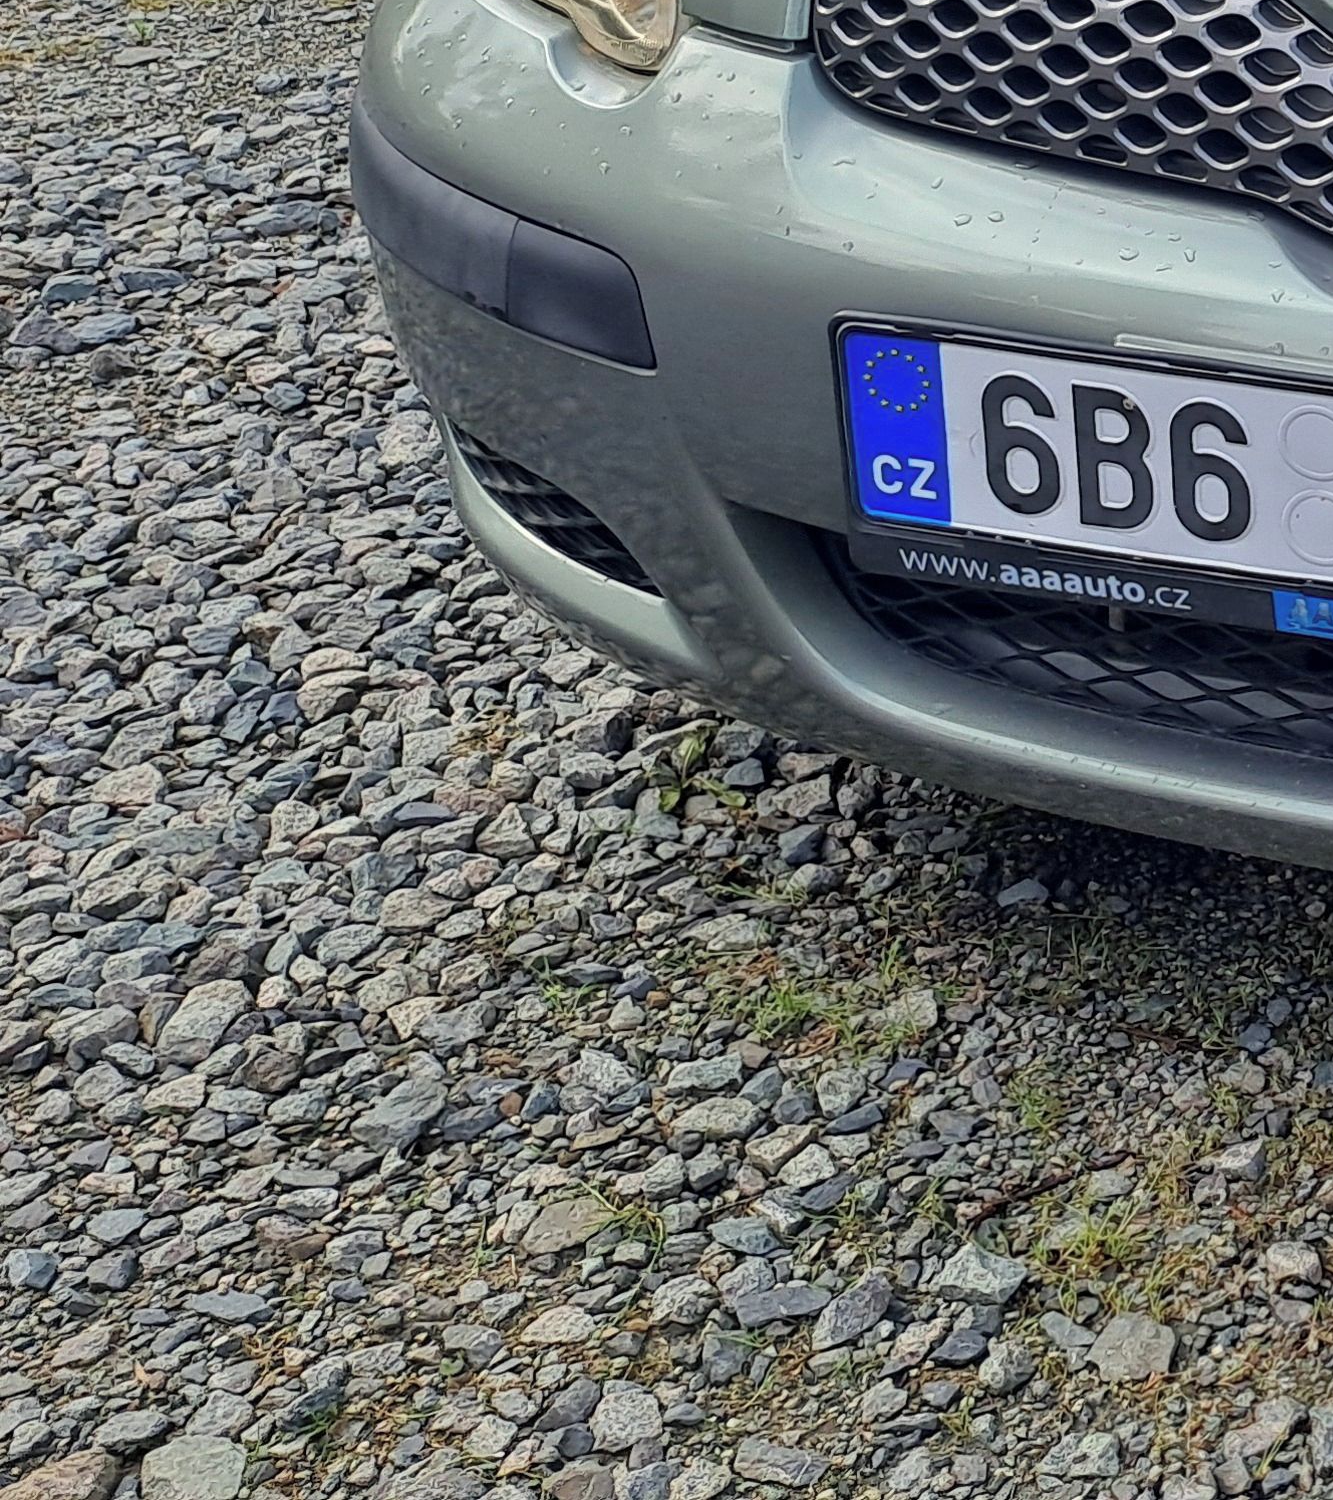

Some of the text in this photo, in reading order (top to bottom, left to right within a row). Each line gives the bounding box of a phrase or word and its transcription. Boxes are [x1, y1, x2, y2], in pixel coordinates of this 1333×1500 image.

[872, 454, 938, 500] CZ
[981, 373, 1252, 542] 6B6
[899, 547, 1192, 611] www.aaaauto.cz
